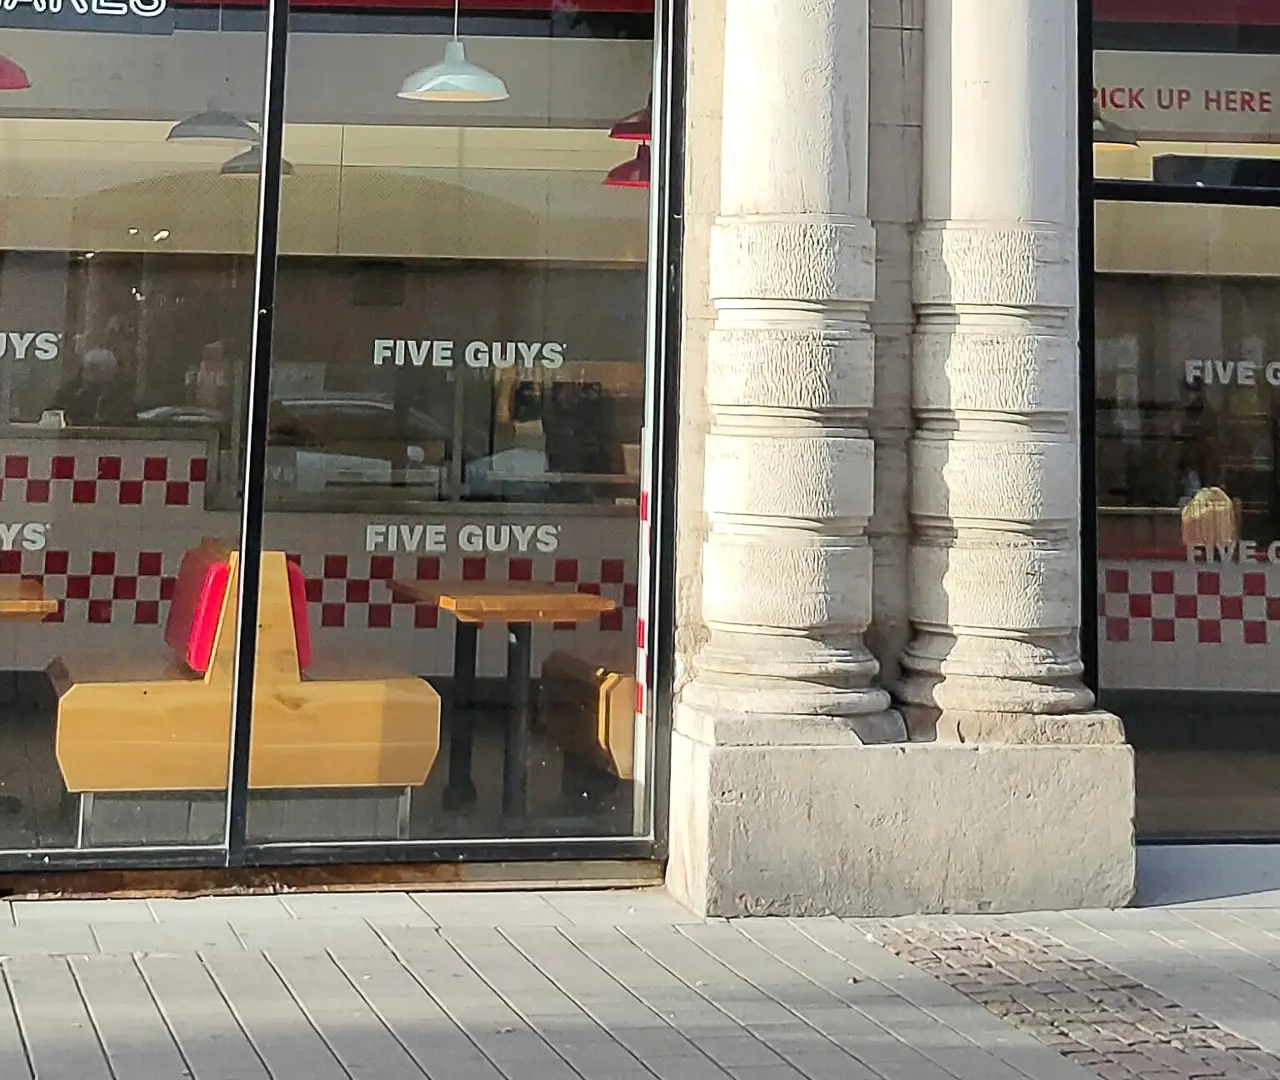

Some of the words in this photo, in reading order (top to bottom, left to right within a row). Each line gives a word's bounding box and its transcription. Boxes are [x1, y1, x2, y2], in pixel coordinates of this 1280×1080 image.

[1157, 88, 1191, 111] UP
[1204, 89, 1272, 113] HERE
[373, 339, 454, 366] FIVE
[464, 341, 565, 369] GUYS
[1185, 360, 1257, 386] FIVE
[366, 525, 446, 553] FIVE
[458, 525, 559, 553] GUYS
[1190, 540, 1257, 565] FIVE
